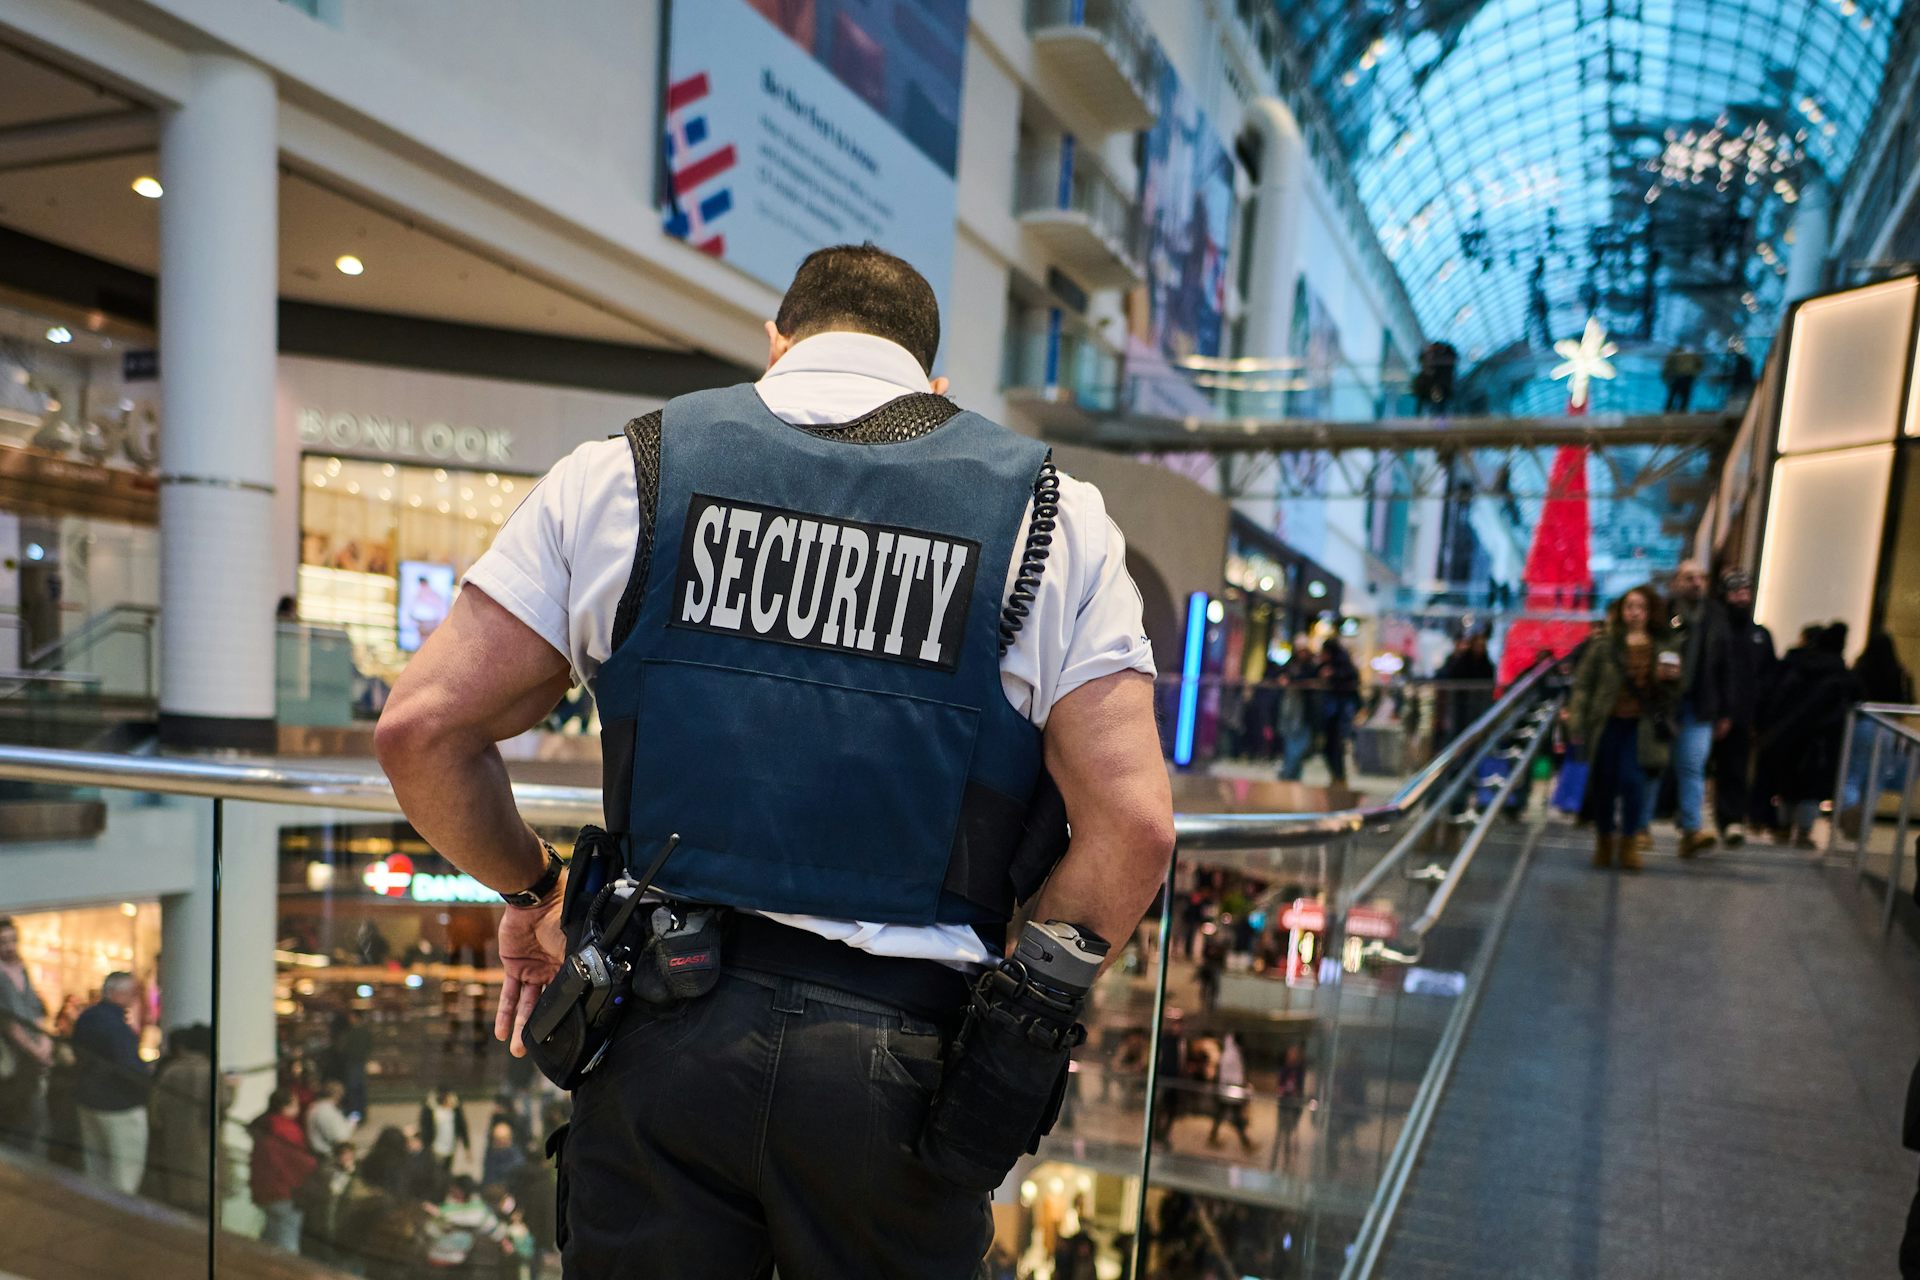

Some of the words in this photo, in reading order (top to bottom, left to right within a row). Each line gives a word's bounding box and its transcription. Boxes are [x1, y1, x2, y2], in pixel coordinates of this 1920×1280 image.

[297, 407, 514, 463] BONLOOK
[682, 504, 968, 663] SECURITY
[669, 954, 706, 967] COAST
